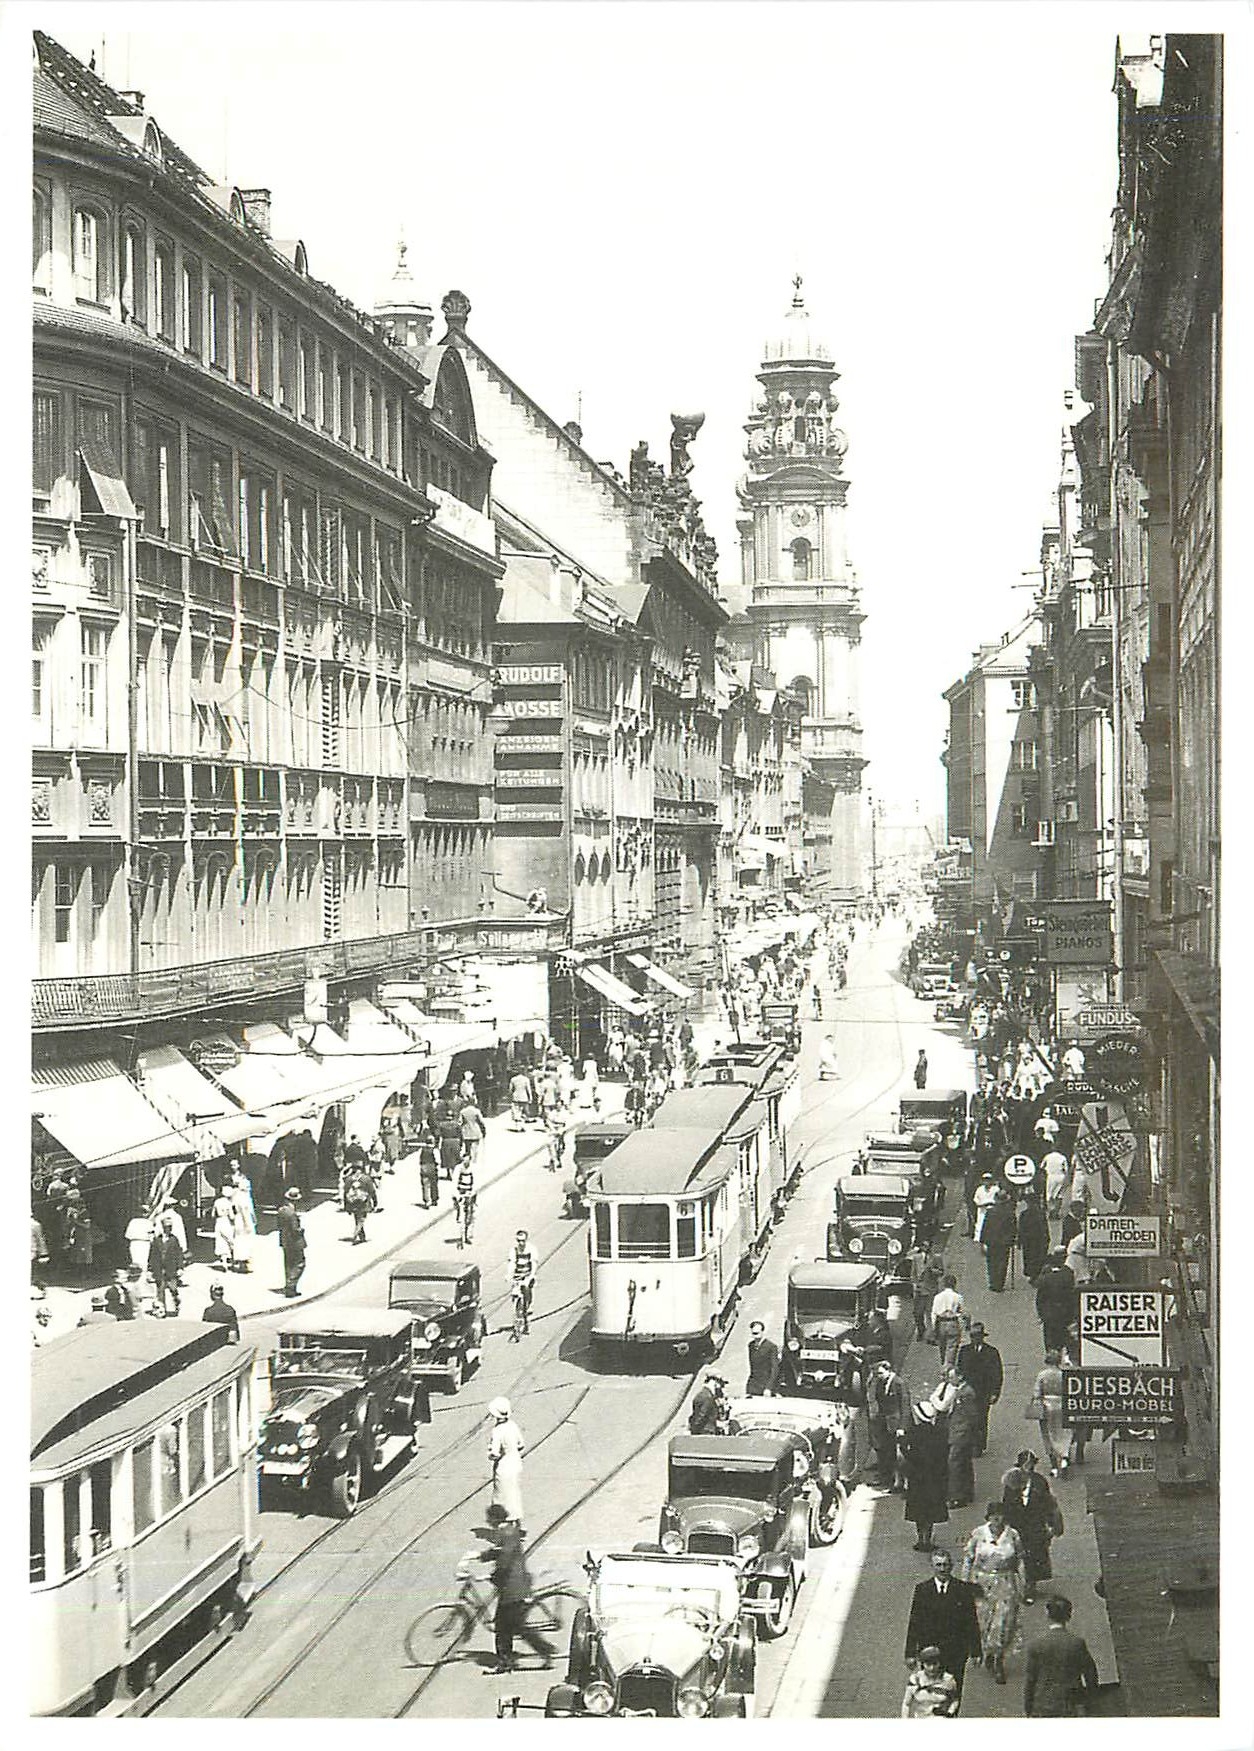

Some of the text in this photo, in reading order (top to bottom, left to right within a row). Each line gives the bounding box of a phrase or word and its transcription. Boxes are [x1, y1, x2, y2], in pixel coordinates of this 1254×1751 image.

[498, 667, 561, 682] RUDOLF
[1079, 1012, 1132, 1025] FUNDUS
[720, 1070, 729, 1081] 6
[1014, 1158, 1027, 1169] P
[1110, 1230, 1157, 1241] MODEN
[1086, 1294, 1156, 1312] RAISER
[1083, 1315, 1159, 1331] SPITZEN
[1067, 1376, 1174, 1396] DIESBACH
